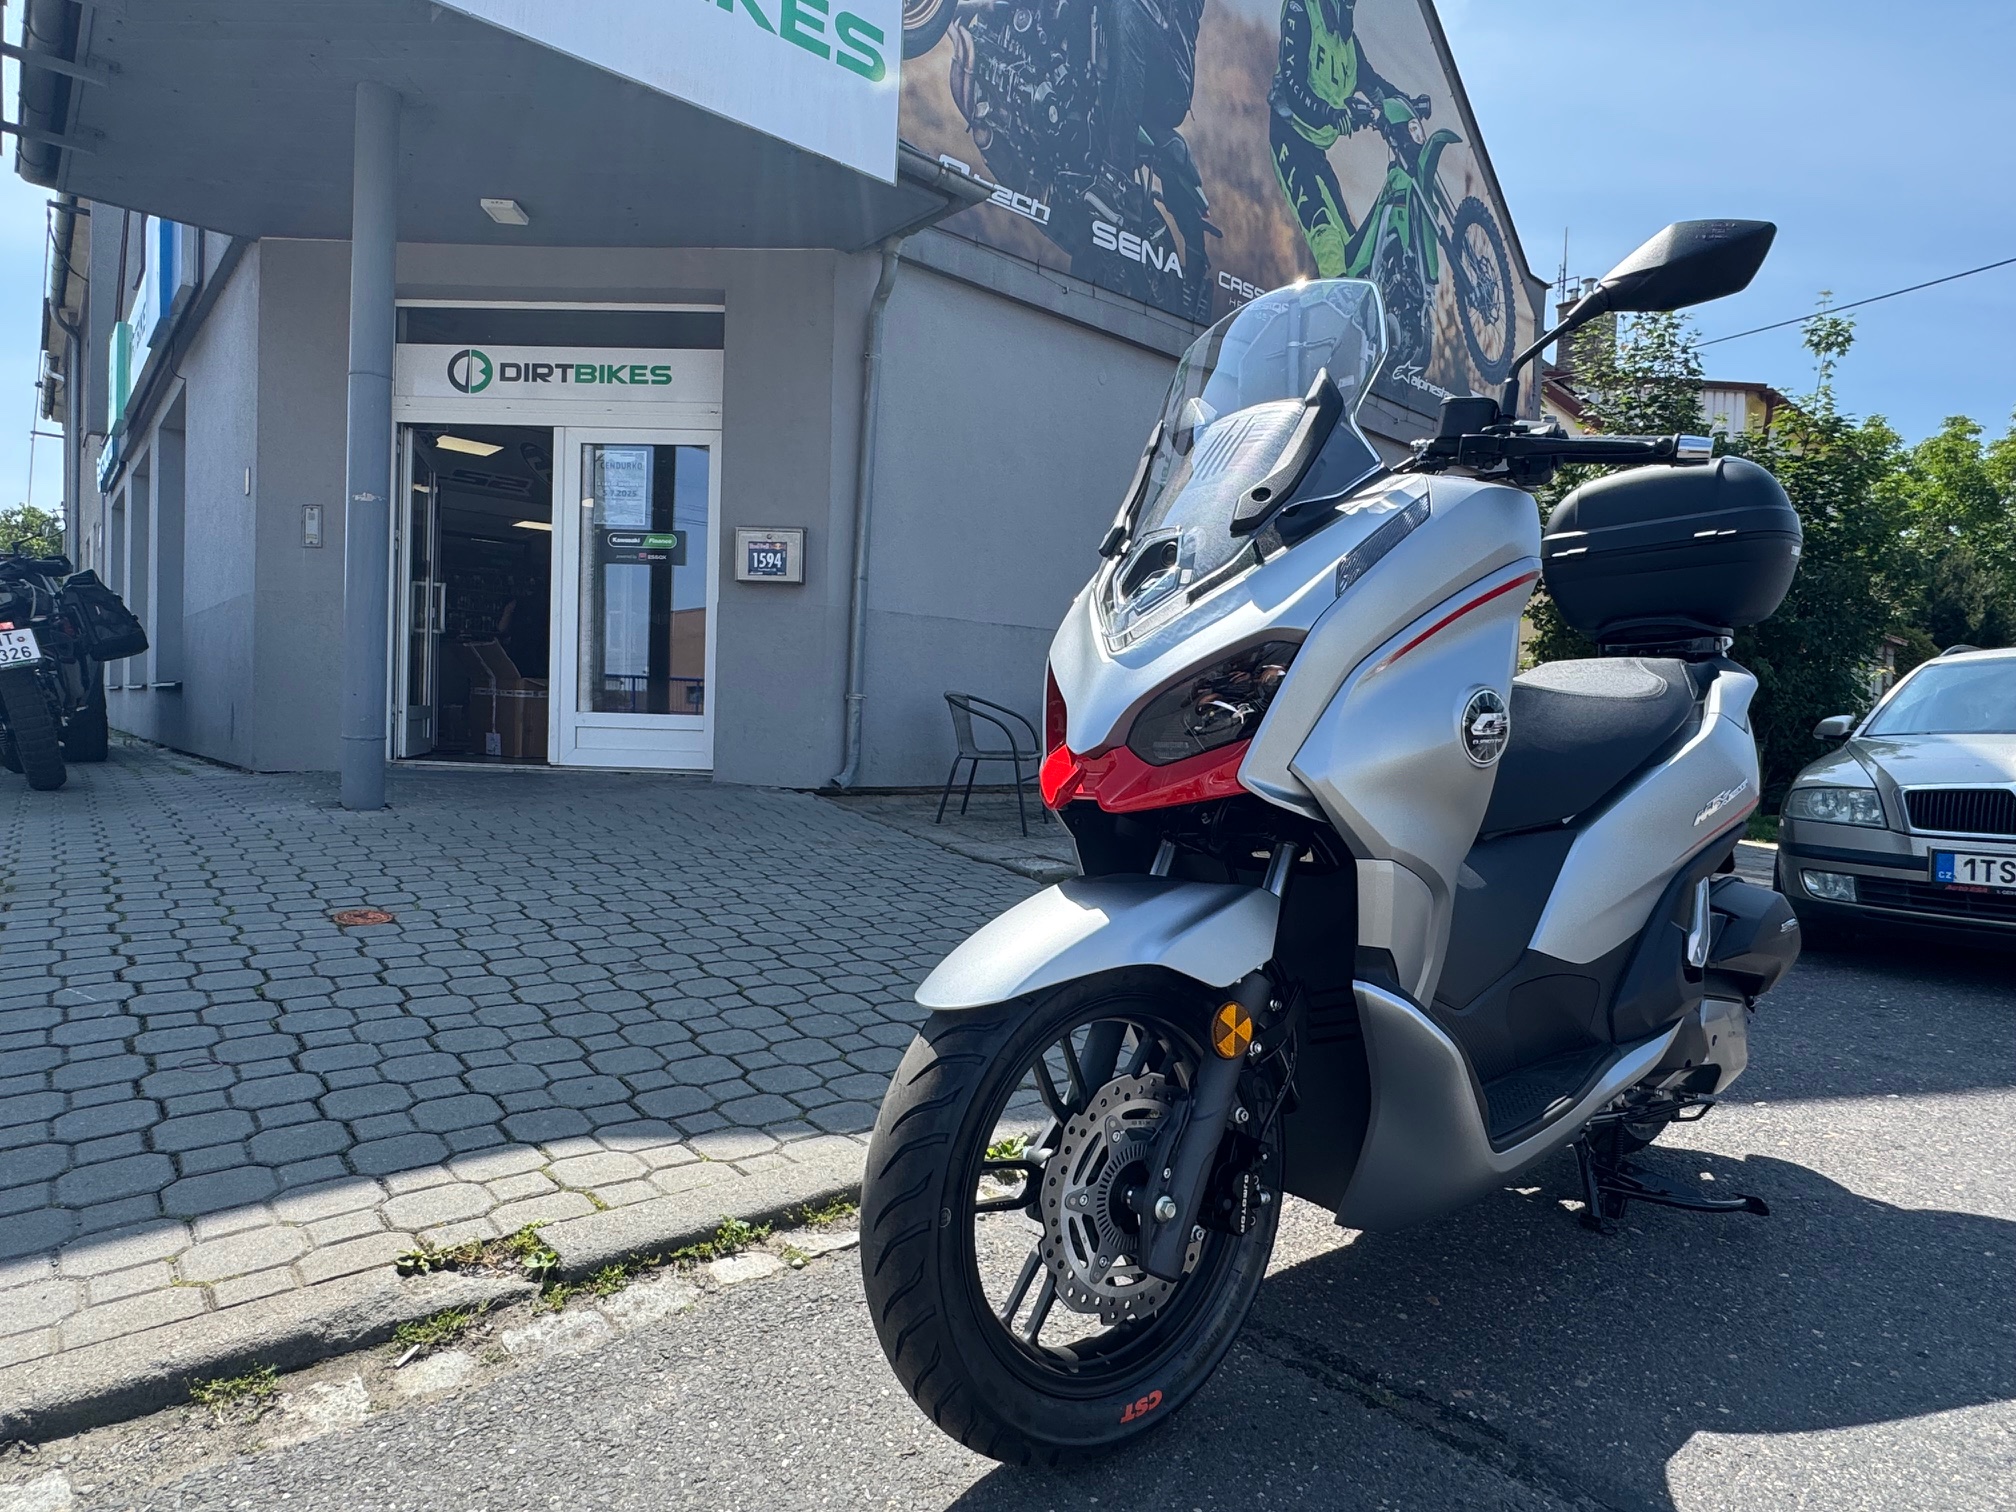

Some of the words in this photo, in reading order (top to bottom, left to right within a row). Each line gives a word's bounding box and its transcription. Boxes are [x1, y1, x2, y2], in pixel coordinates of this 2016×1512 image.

[1316, 43, 1349, 89] FLY
[1279, 142, 1309, 210] FLY
[1092, 219, 1183, 280] SENA
[499, 362, 673, 386] DIRTBIKES
[753, 552, 782, 568] 1594
[0, 633, 12, 647] T
[0, 646, 31, 661] 326
[1938, 870, 1953, 879] CZ
[1963, 857, 2016, 884] 1TS
[1120, 1389, 1163, 1424] CST
